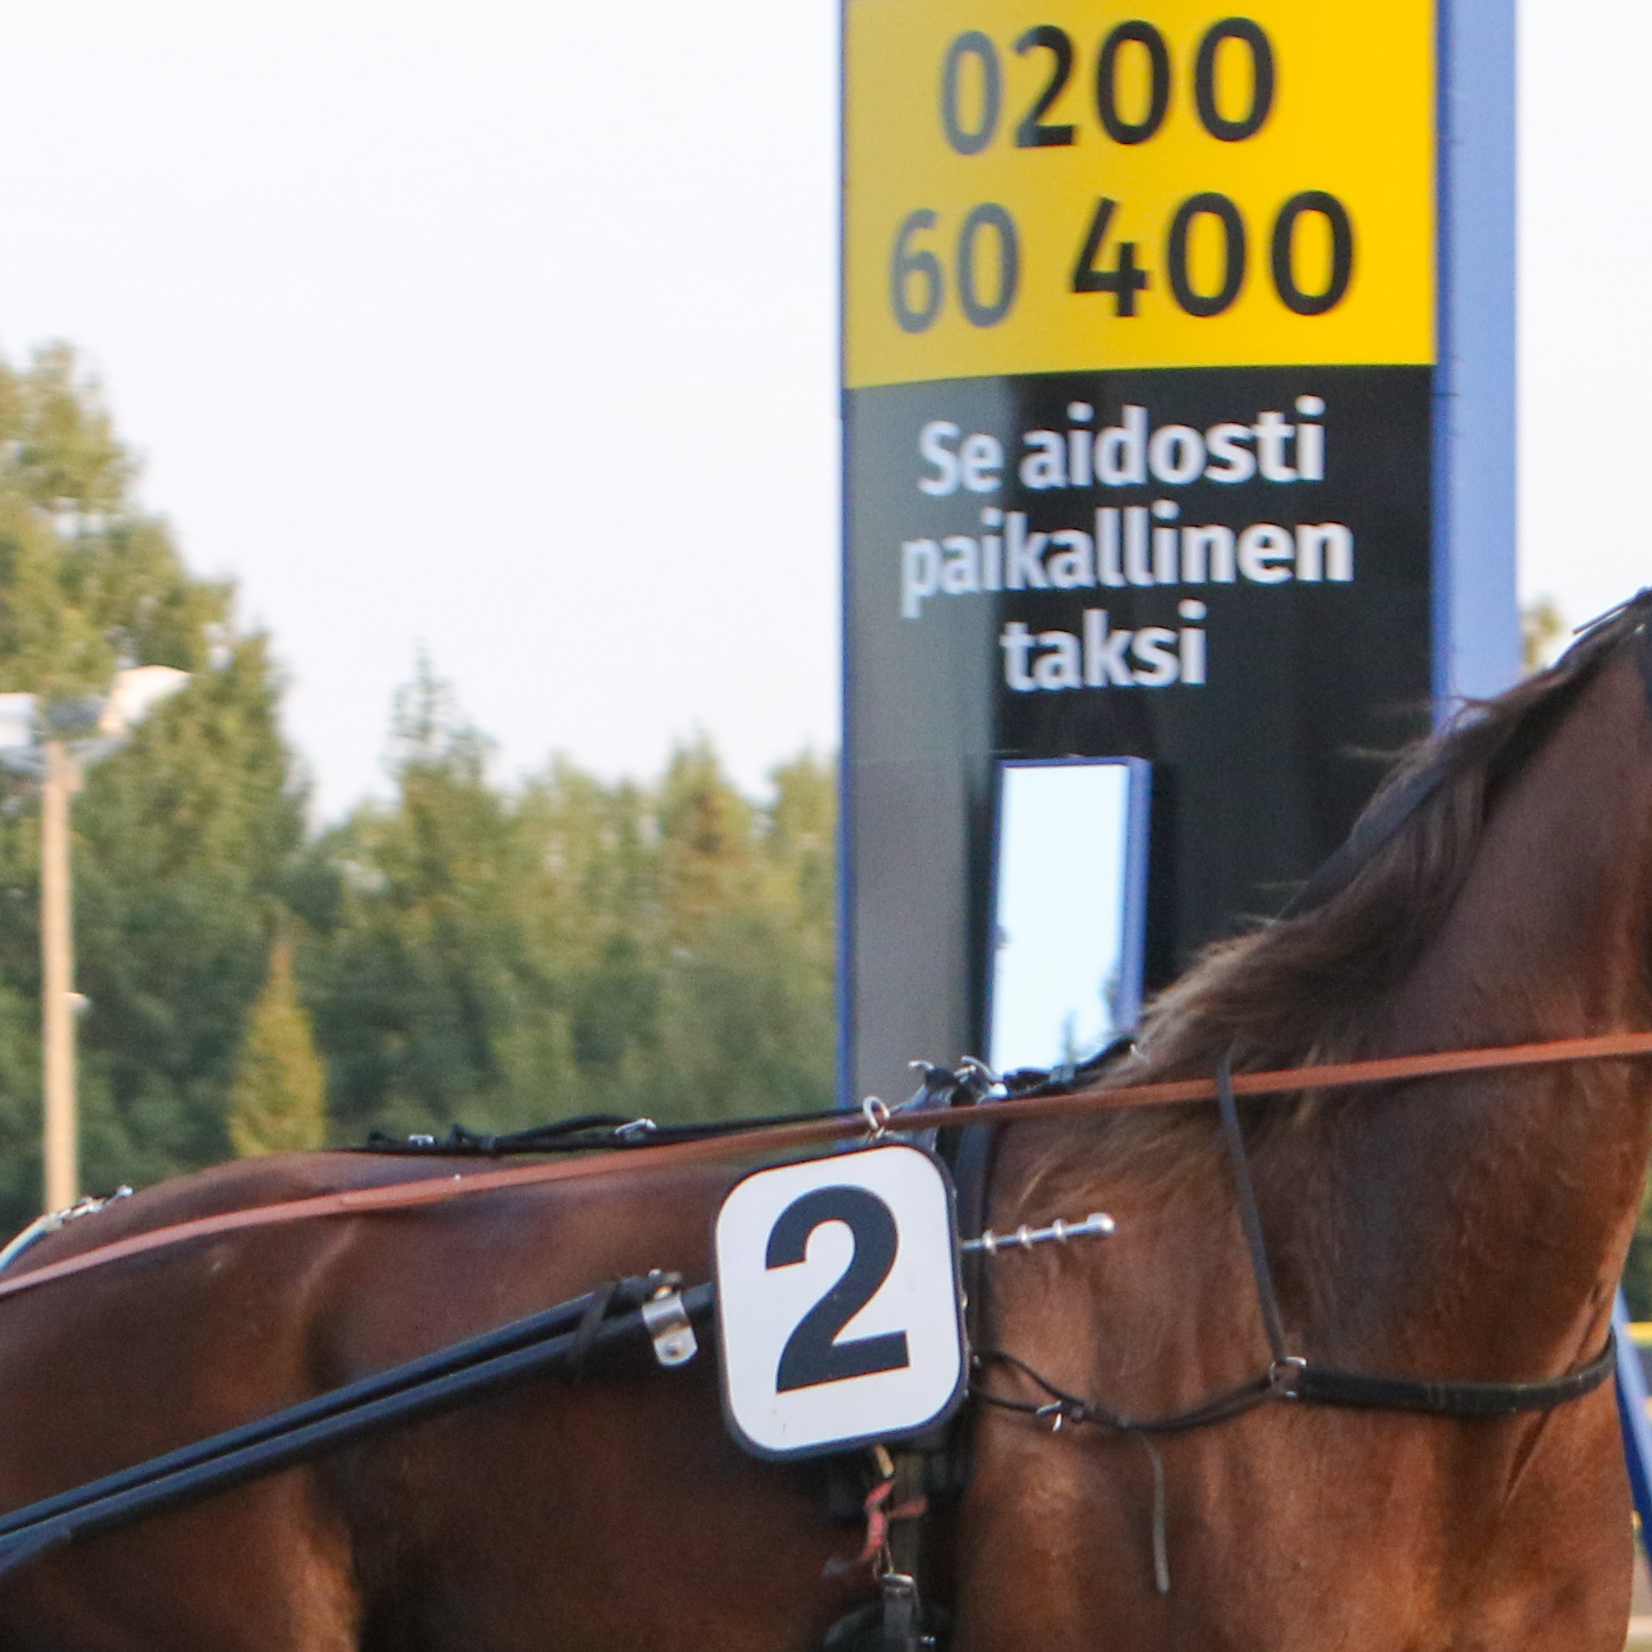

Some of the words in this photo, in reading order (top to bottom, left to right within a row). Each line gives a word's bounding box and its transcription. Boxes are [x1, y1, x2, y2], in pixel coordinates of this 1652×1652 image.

[940, 16, 1278, 156] 0200
[889, 202, 1021, 334] 60
[1071, 190, 1354, 319] 400
[917, 420, 1005, 497] Se
[1021, 395, 1326, 489] aidosti
[900, 499, 1354, 619] paikallinen
[1000, 599, 1207, 692] taksi
[765, 1184, 911, 1395] 2
